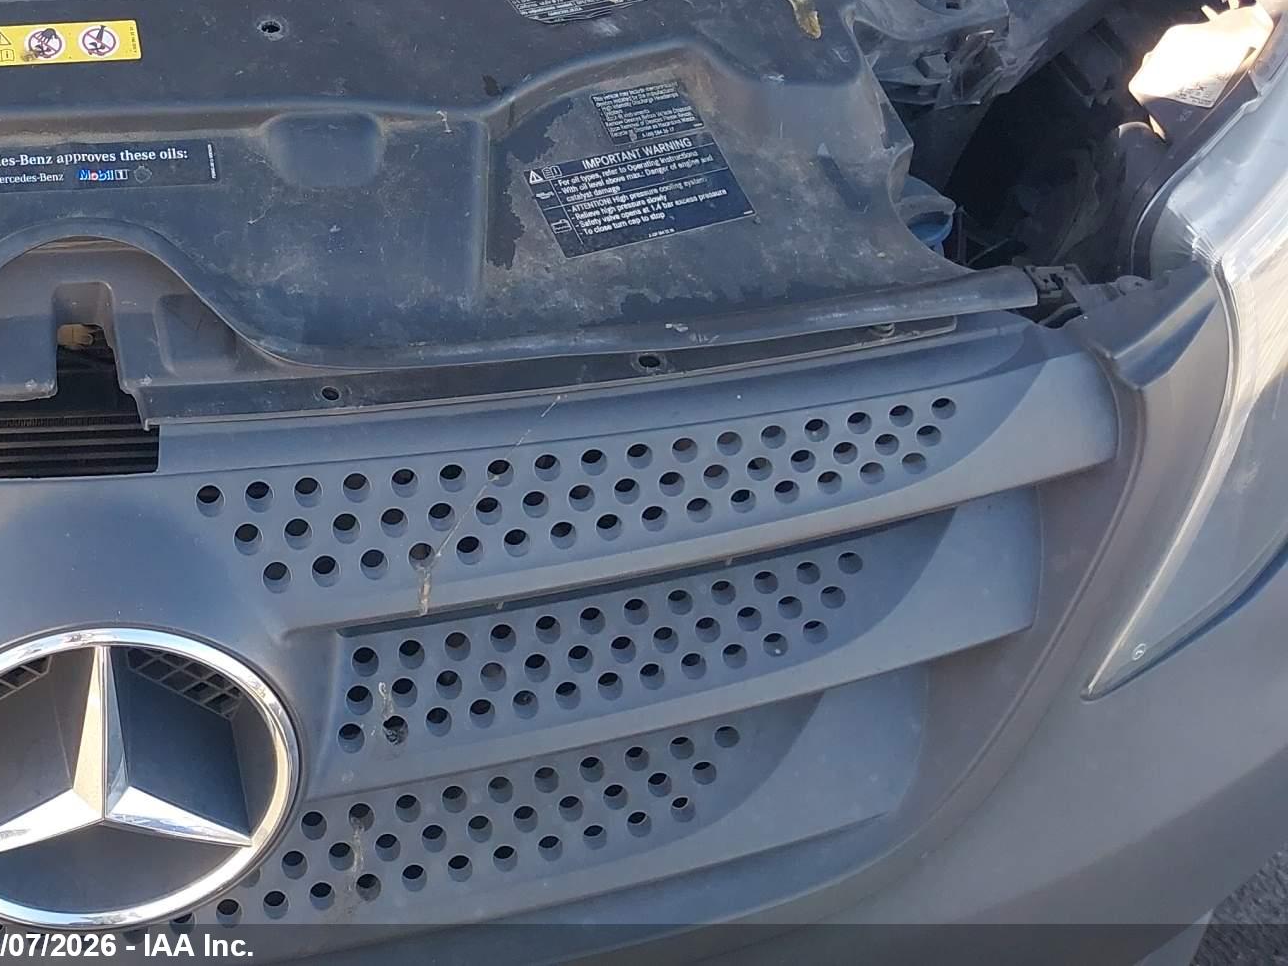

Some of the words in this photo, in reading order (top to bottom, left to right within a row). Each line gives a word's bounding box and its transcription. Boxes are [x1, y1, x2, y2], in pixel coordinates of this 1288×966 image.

[56, 153, 116, 165] approves
[120, 150, 156, 161] these
[159, 148, 188, 160] oils:
[582, 148, 641, 169] IMPORTANT
[642, 137, 692, 156] WARNING
[79, 170, 113, 181] Mobil
[557, 179, 570, 187] For
[570, 175, 581, 184] oil
[579, 172, 602, 183] types,
[601, 168, 618, 177] refer
[618, 166, 627, 174] to
[627, 159, 661, 172] Operating
[561, 185, 579, 195] With
[579, 182, 589, 191] oil
[587, 179, 605, 189] level
[605, 175, 626, 185] above
[644, 165, 669, 176] Danger
[669, 162, 678, 171] of
[677, 158, 700, 169] engine
[700, 154, 714, 164] and
[566, 190, 593, 202] catalyst
[593, 185, 621, 197] damage
[571, 197, 613, 212] ATTENTION!
[611, 194, 629, 203] High
[629, 188, 659, 201] pressure
[658, 182, 684, 193] cooling
[574, 210, 601, 220] Relieve
[600, 206, 617, 215] high
[616, 199, 646, 212] pressure
[646, 194, 667, 204] slowly
[579, 218, 602, 228] Safety
[602, 214, 620, 222] valve
[620, 209, 642, 219] opens
[642, 206, 650, 214] at
[650, 203, 662, 211] 1.4
[661, 201, 674, 209] bar
[674, 195, 698, 206] excess
[697, 189, 727, 202] pressure
[593, 224, 613, 233] close
[612, 220, 628, 229] turn
[627, 217, 641, 226] cap
[649, 212, 666, 220] stop
